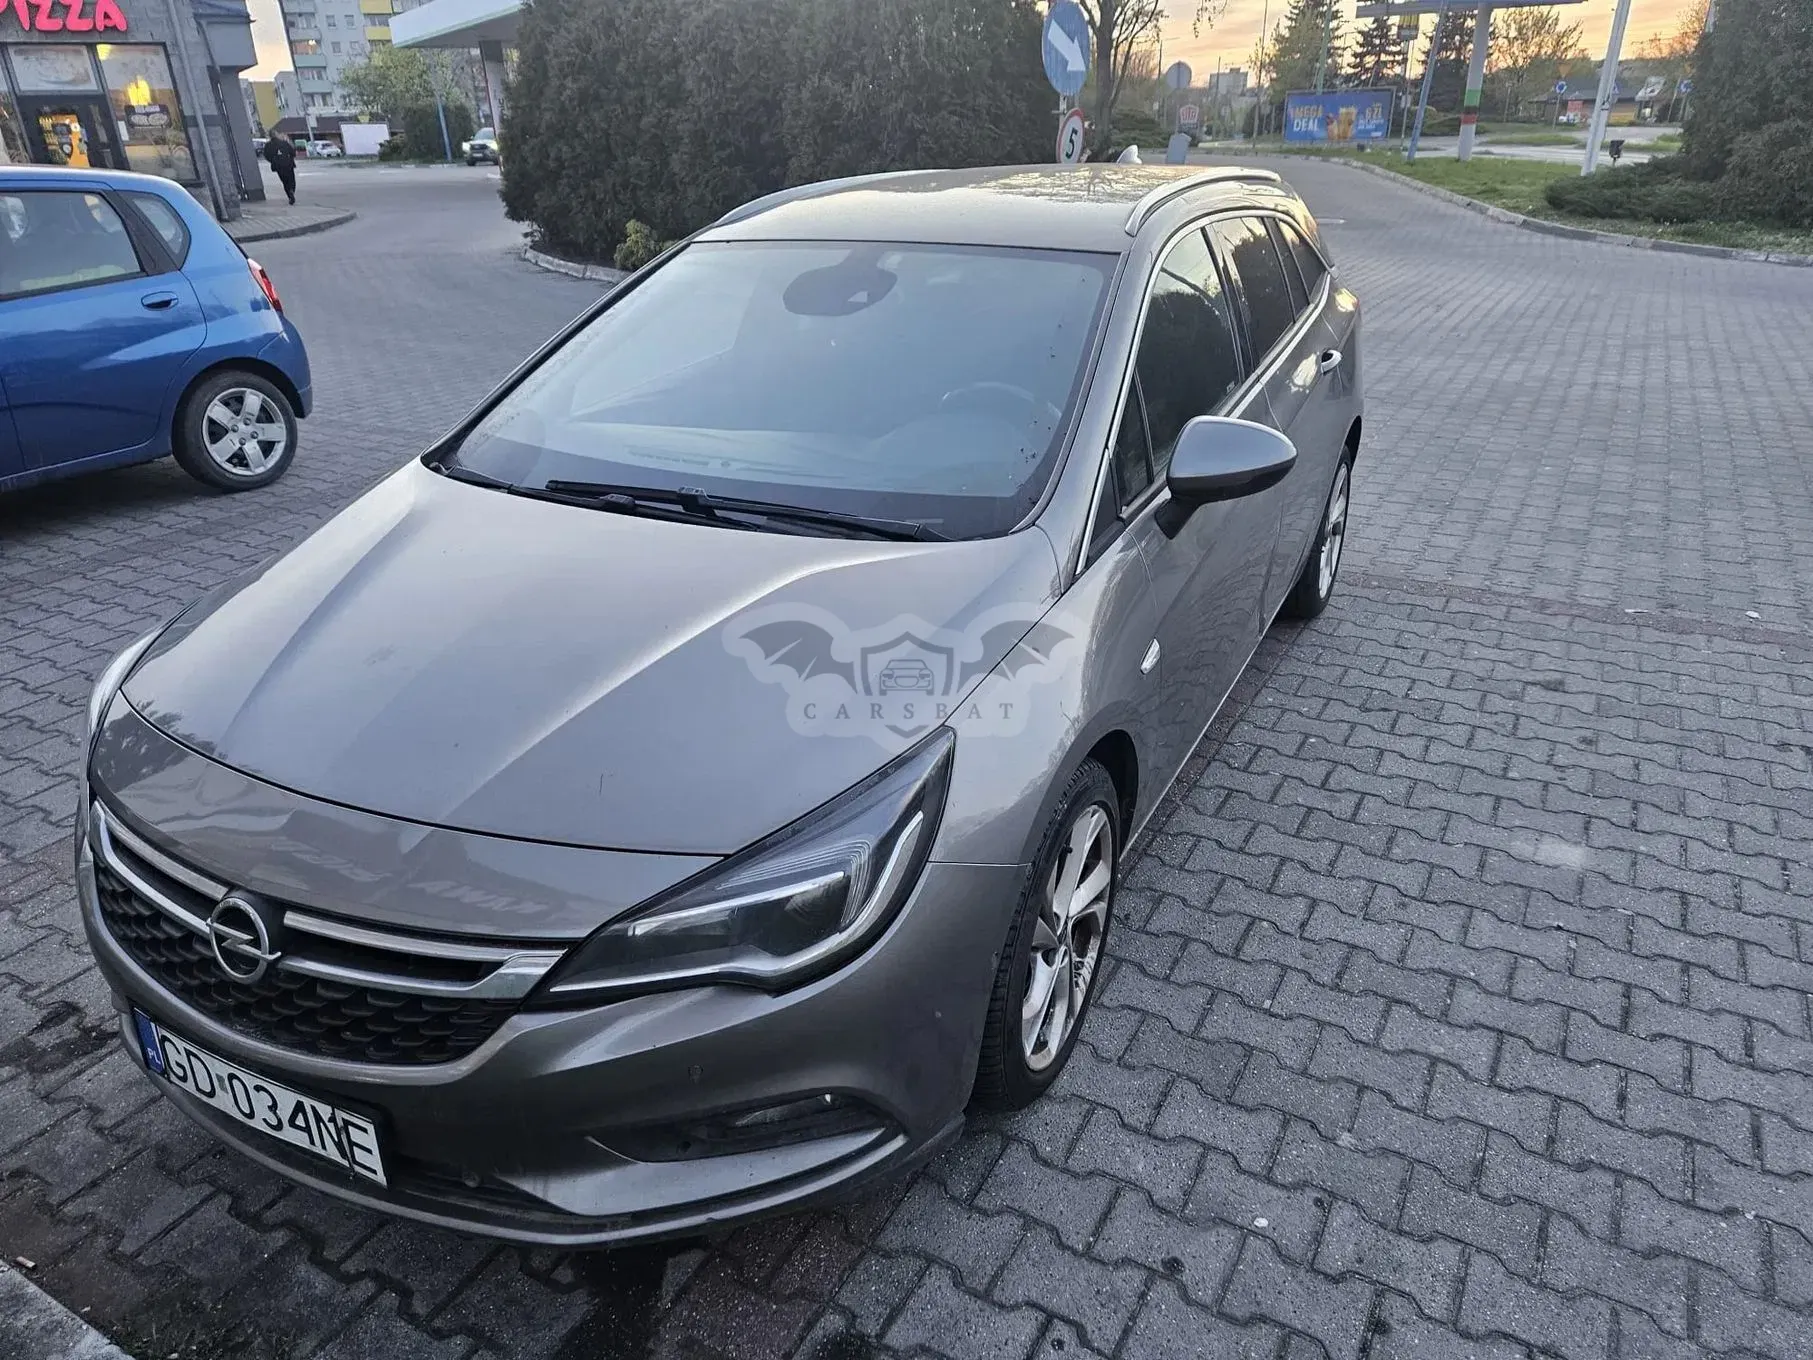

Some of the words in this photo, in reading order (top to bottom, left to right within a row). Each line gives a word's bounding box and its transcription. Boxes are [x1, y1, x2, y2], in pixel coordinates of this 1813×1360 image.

[1293, 118, 1320, 132] DEAL
[1065, 127, 1078, 159] 5
[146, 1047, 161, 1065] PL
